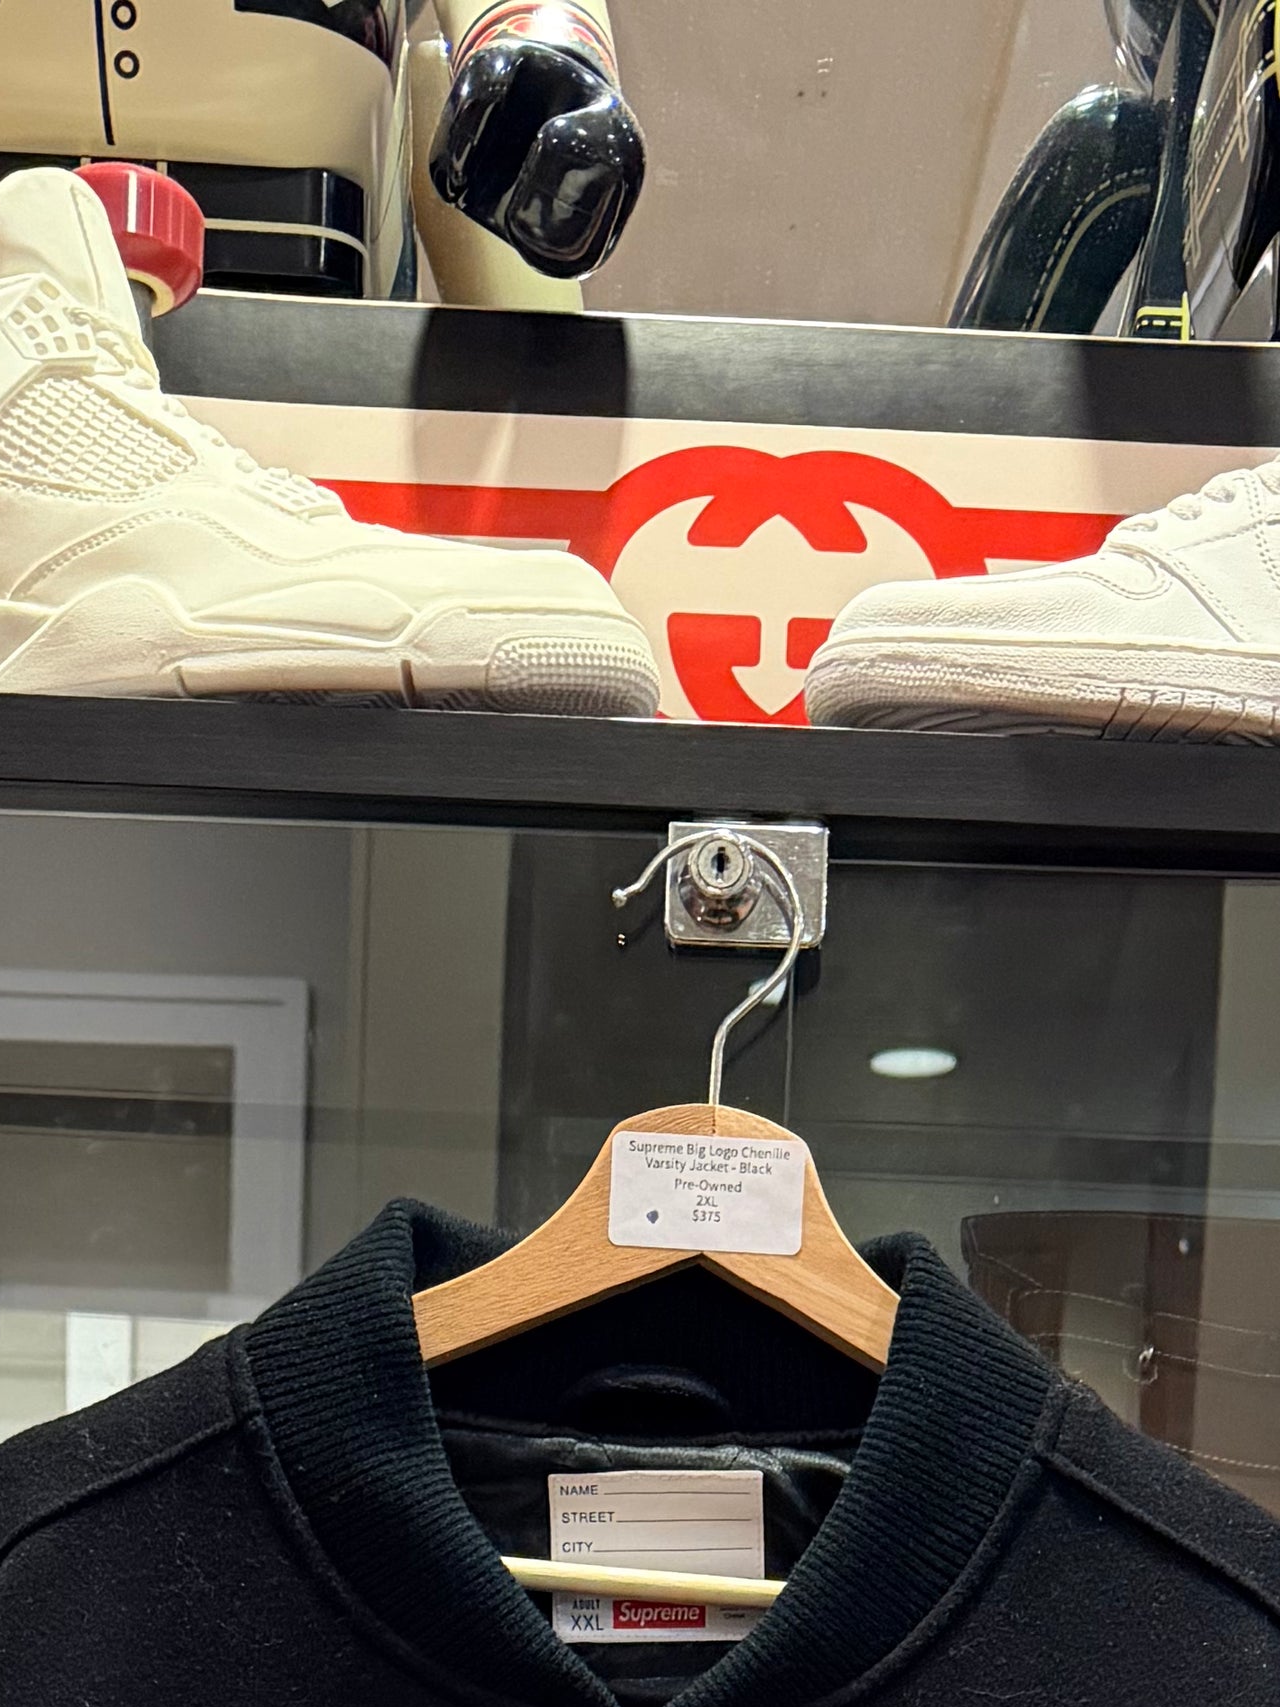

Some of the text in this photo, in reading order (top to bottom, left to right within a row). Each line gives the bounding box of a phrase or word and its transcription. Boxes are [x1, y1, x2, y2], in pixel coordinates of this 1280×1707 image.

[629, 1140, 791, 1161] Supreme Big Logo Chenille
[645, 1156, 687, 1173] Varsity
[689, 1160, 729, 1173] Jacket
[739, 1162, 773, 1175] Black
[674, 1178, 742, 1193] Pre-Owned
[696, 1195, 719, 1207] 2XL
[692, 1210, 721, 1223] $375
[559, 1484, 599, 1497] NAME
[561, 1511, 616, 1524] STREET
[562, 1541, 593, 1554] CITY
[619, 1602, 700, 1626] Supreme
[571, 1614, 604, 1632] XXL
